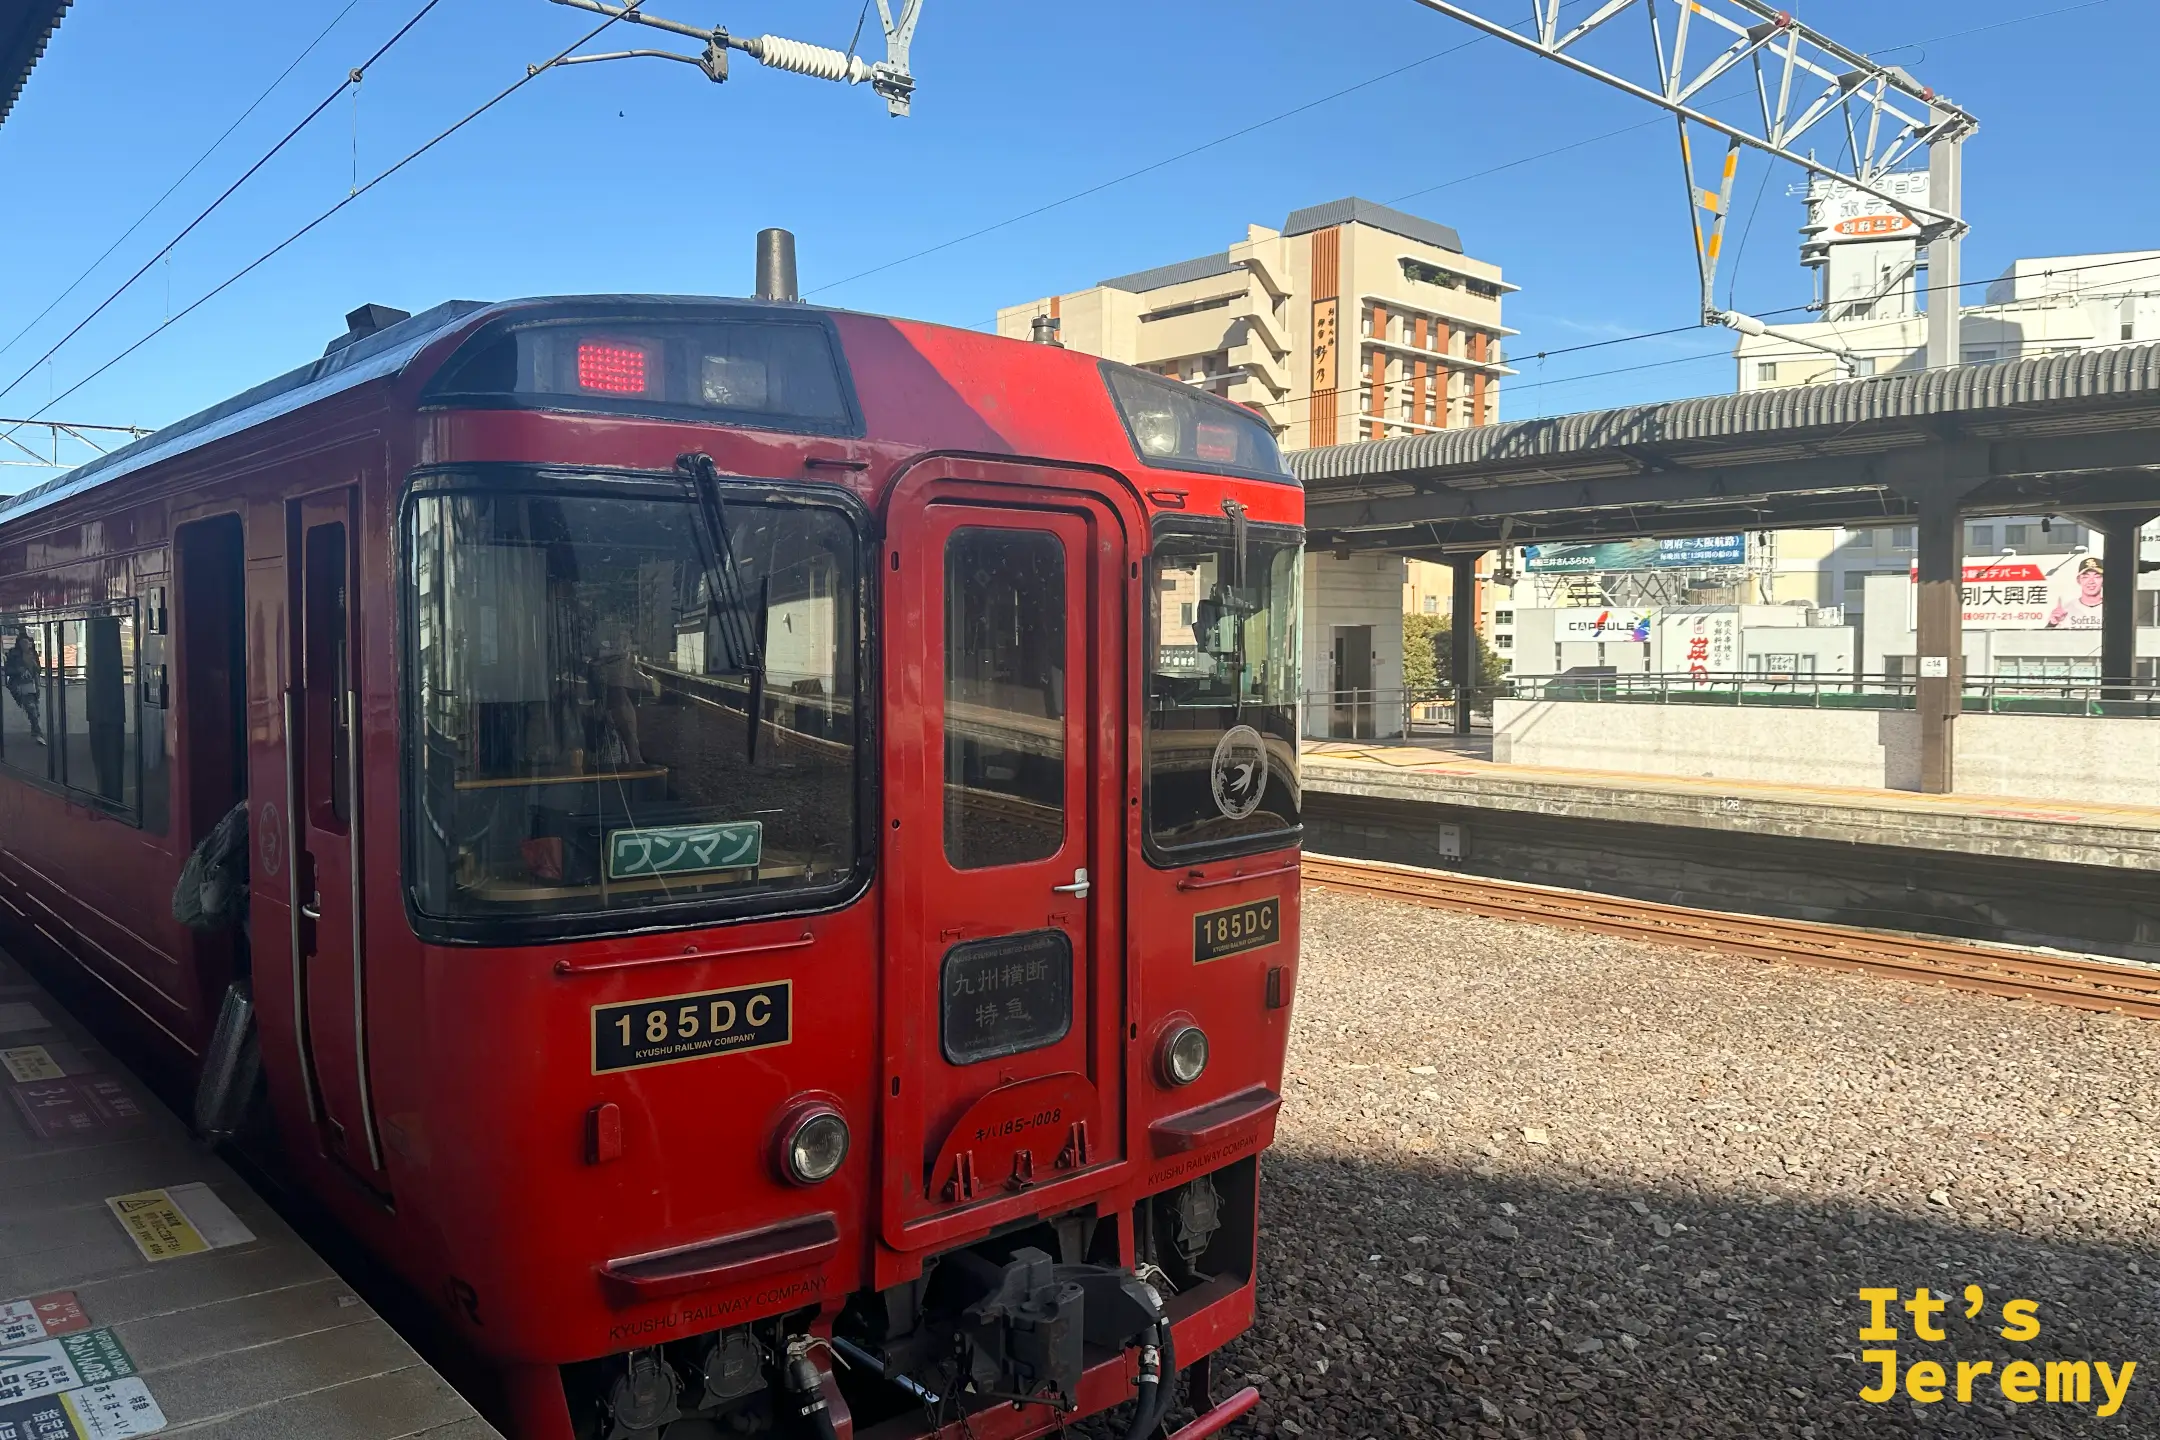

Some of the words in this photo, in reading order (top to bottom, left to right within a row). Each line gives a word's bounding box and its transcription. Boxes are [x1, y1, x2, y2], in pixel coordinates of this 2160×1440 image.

[1818, 176, 1929, 200] ステション
[1840, 199, 1893, 217] ホテ
[1841, 217, 1904, 234] 別府温泉
[1962, 585, 2048, 606] 別大興産
[1568, 622, 1635, 631] CAPSULE
[618, 830, 753, 872] ワンマン
[1203, 906, 1272, 944] 185DC
[953, 958, 1048, 996] 九州横断
[615, 994, 771, 1046] 185DC
[976, 997, 1031, 1028] 特急
[636, 1046, 673, 1059] KYUSHU
[675, 1039, 713, 1052] RAILWAY
[714, 1032, 756, 1046] COMPANY
[1148, 1165, 1184, 1186] KYUSHU
[1186, 1151, 1222, 1174] RAILWAY
[1222, 1132, 1260, 1158] COMPANY
[38, 1302, 68, 1327] ゆふ
[609, 1314, 678, 1342] KYUSHU
[683, 1296, 753, 1325] RAILWAY
[756, 1275, 830, 1306] COMPANY
[64, 1334, 113, 1382] ゆふいんの森
[24, 1370, 50, 1391] CAR
[128, 1395, 150, 1412] 特急
